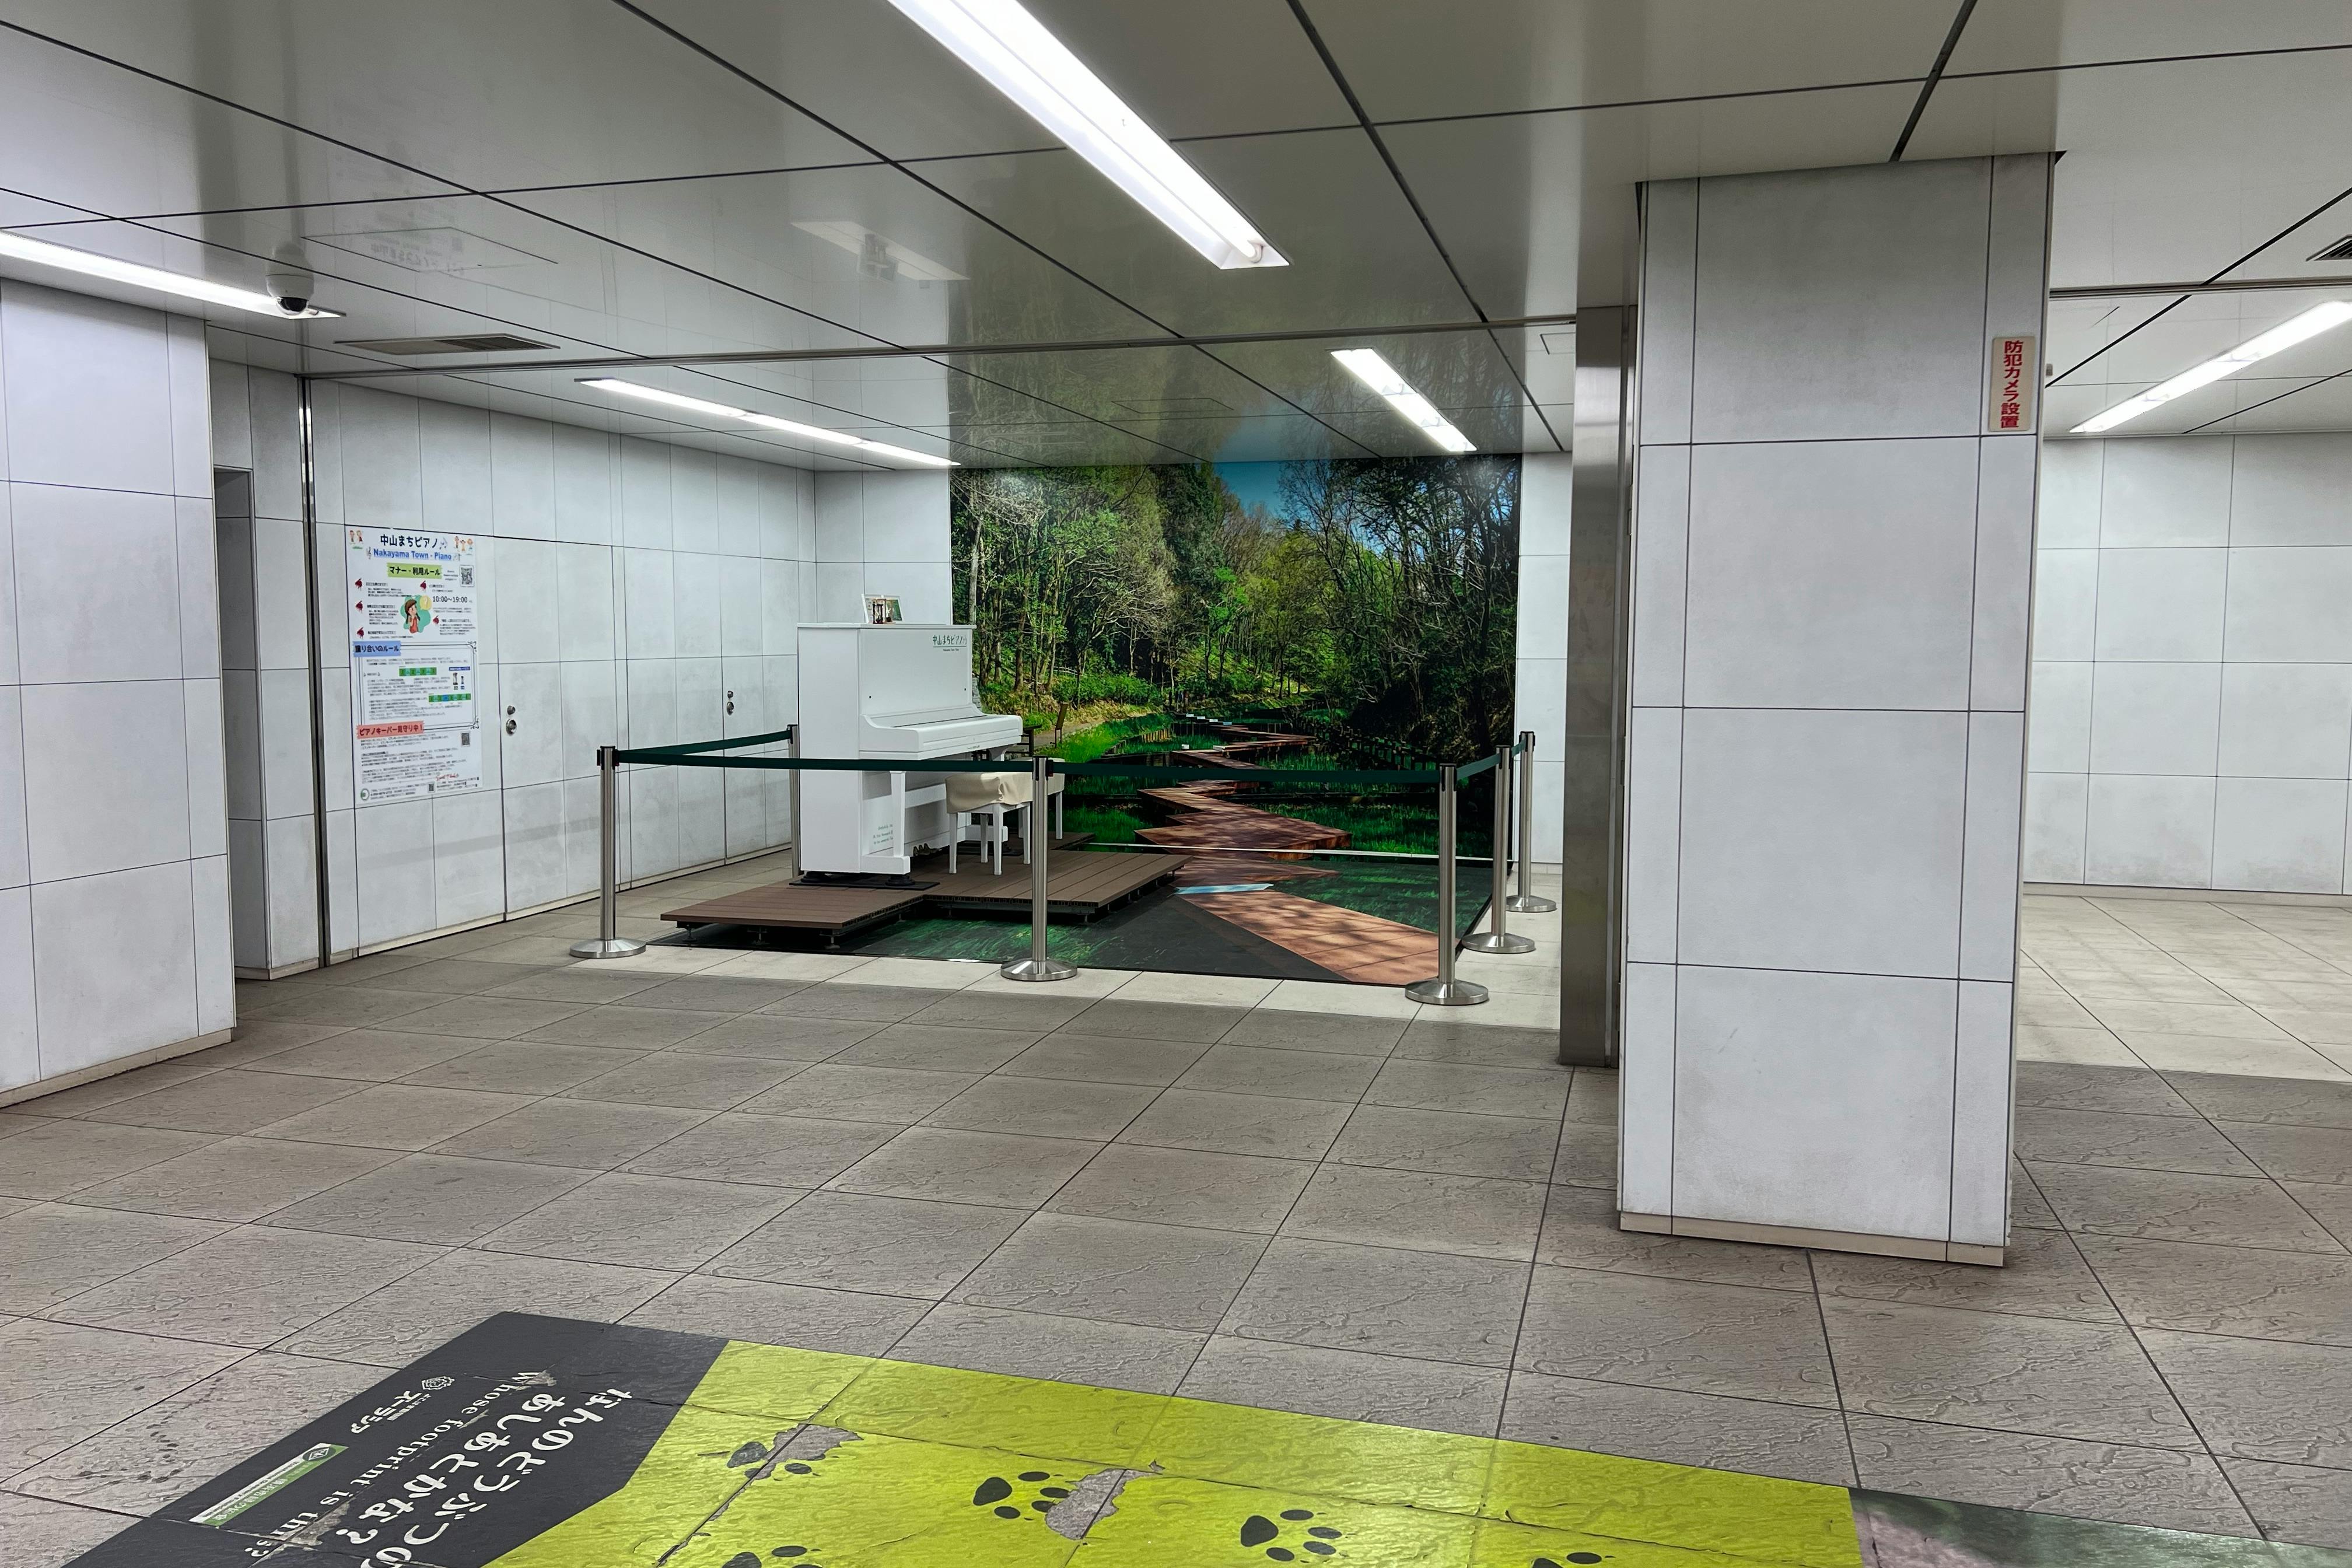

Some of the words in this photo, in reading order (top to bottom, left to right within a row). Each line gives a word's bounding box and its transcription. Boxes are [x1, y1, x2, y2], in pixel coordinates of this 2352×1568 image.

[2000, 340, 2024, 428] 防犯カメラ設置
[373, 548, 410, 559] Nakayama
[411, 551, 429, 559] Town
[434, 552, 452, 561] Piano
[380, 534, 438, 548] 中山まちピアノ
[389, 566, 440, 576] マナー・利用ルール
[351, 1391, 422, 1434] ズーラシア
[336, 1394, 565, 1544] あしあとかな?
[350, 1419, 464, 1486] footprint
[320, 1490, 354, 1505] is
[360, 1388, 632, 1568] なんのどうぶつの
